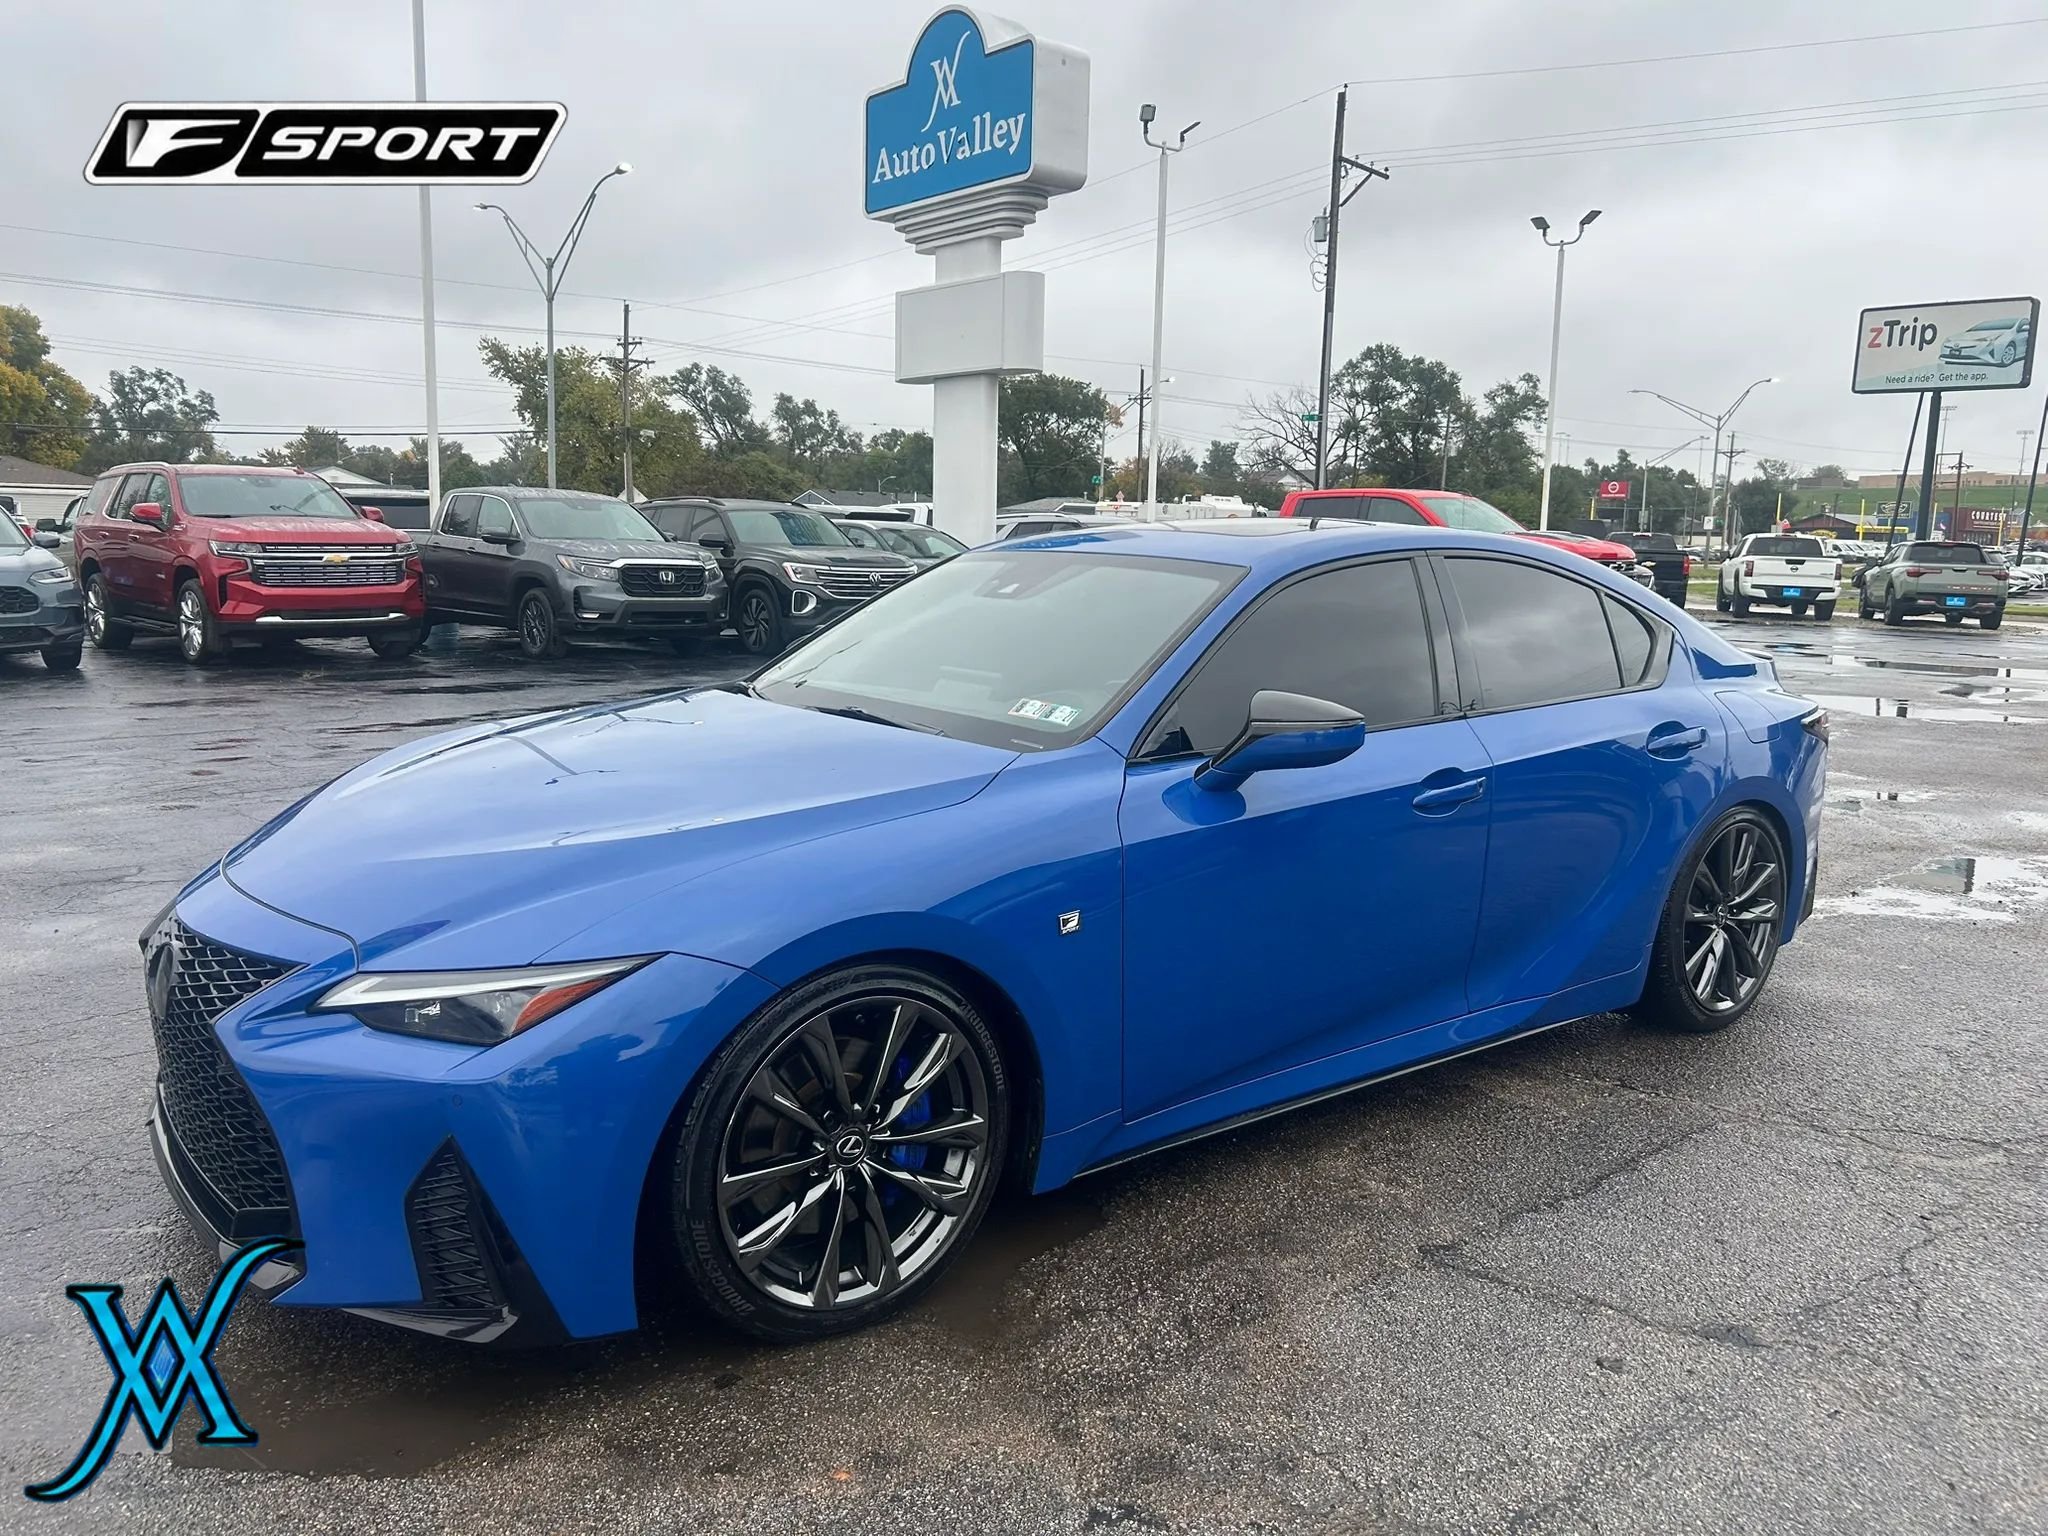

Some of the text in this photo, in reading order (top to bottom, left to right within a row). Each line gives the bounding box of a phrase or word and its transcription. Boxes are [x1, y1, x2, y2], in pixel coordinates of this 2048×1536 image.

[1867, 317, 1938, 351] zTrip
[1885, 375, 1907, 384] Need
[1914, 373, 1935, 383] ride?
[1938, 373, 1953, 382] Get
[1955, 372, 1968, 381] the
[1970, 372, 1988, 382] app.
